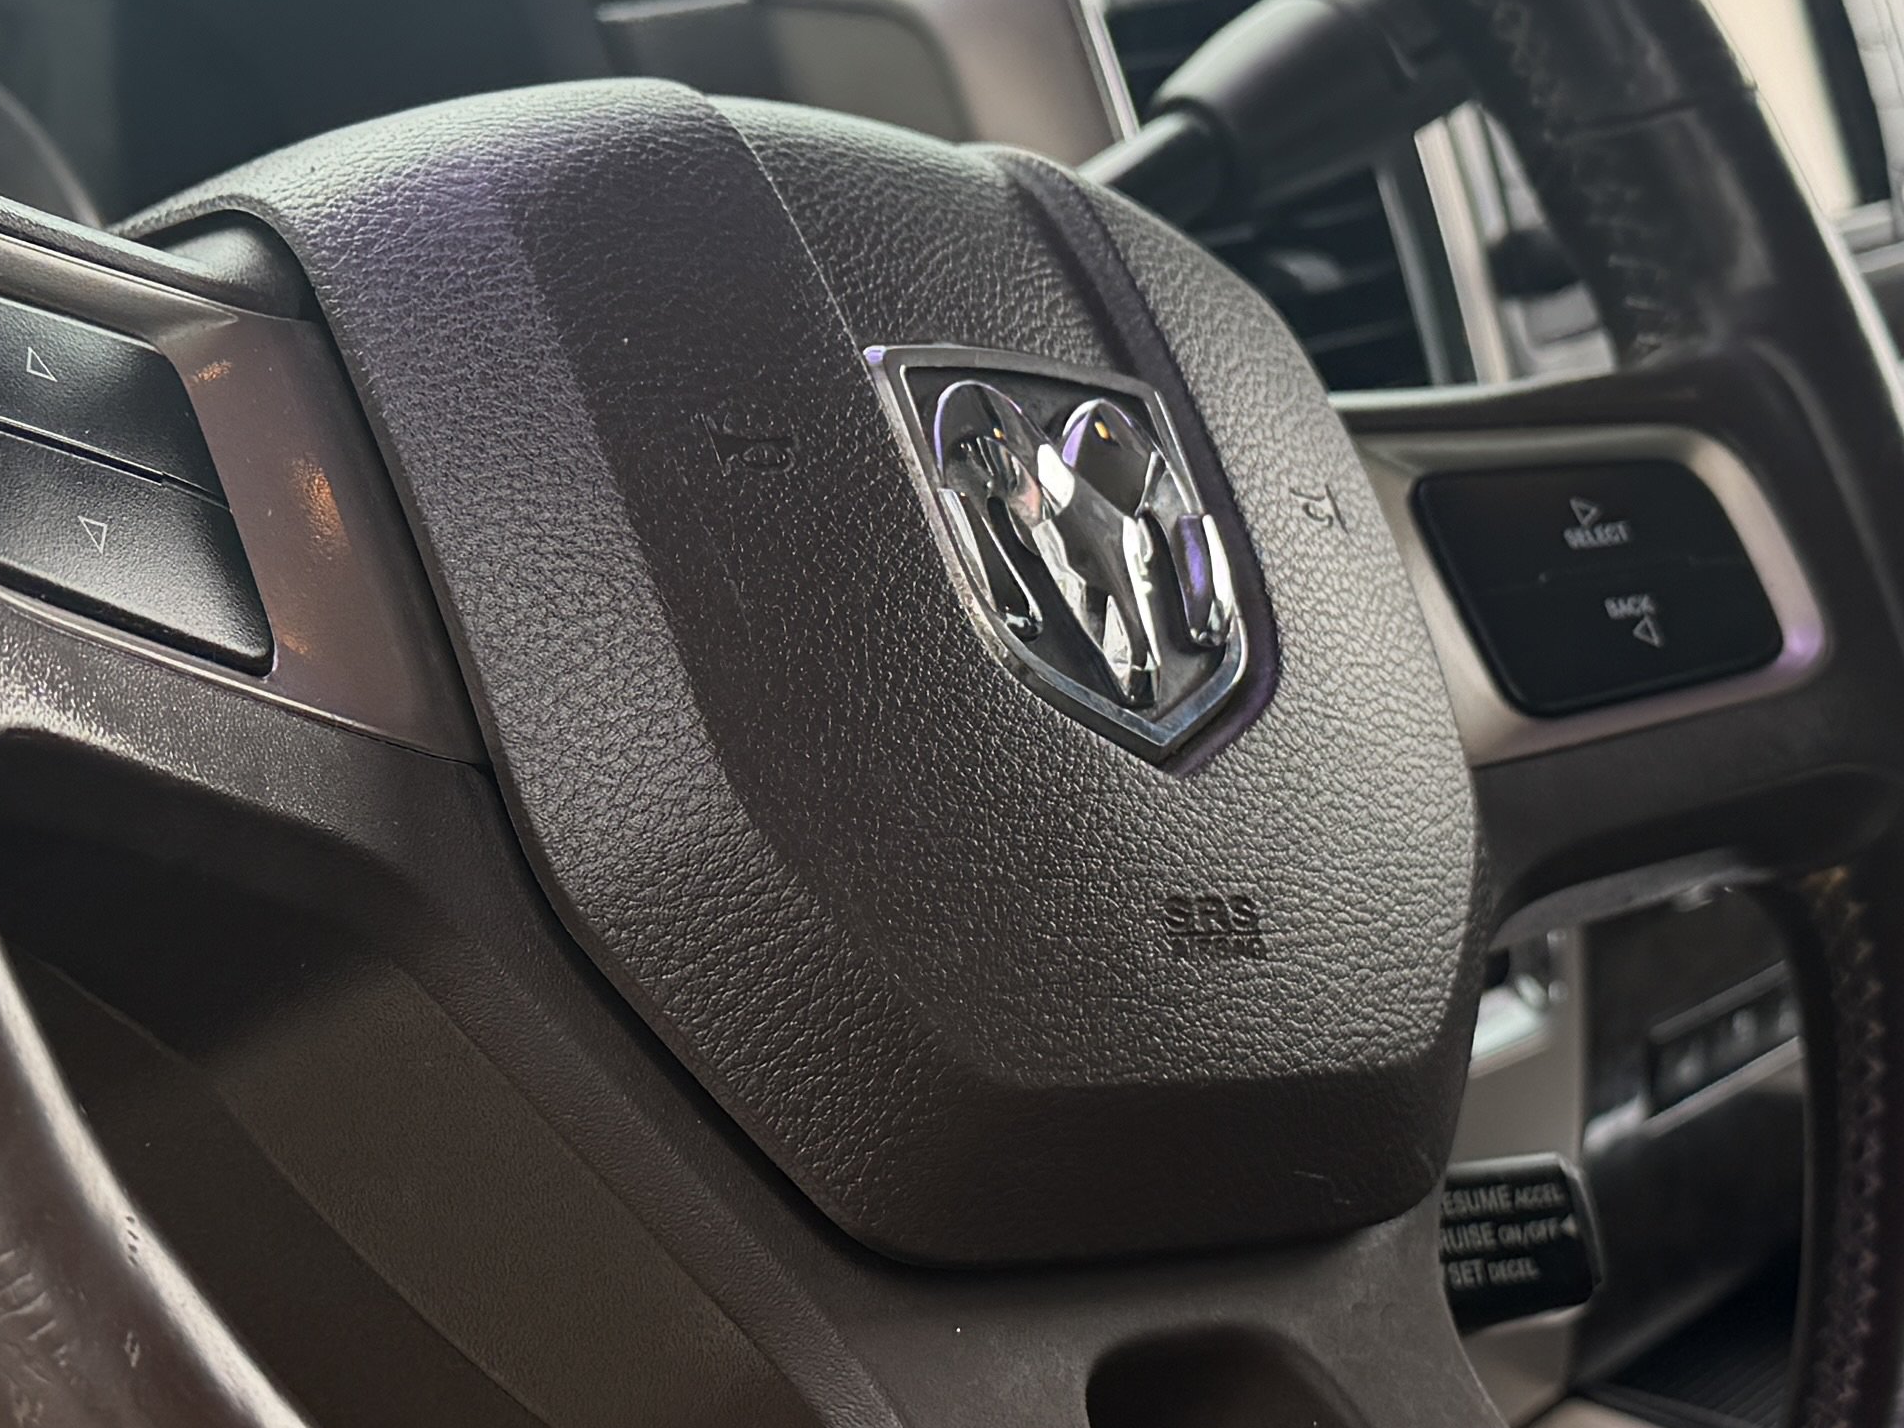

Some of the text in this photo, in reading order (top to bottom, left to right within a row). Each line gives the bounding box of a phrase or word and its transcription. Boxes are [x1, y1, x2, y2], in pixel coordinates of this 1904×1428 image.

[1563, 522, 1629, 549] SELECT
[1605, 594, 1655, 619] BACK
[1162, 895, 1259, 933] SRS
[1441, 1183, 1564, 1215] ESUME ACCEL
[1440, 1218, 1558, 1252] RUISE ON/OFF
[1449, 1258, 1537, 1289] SET DECEL
